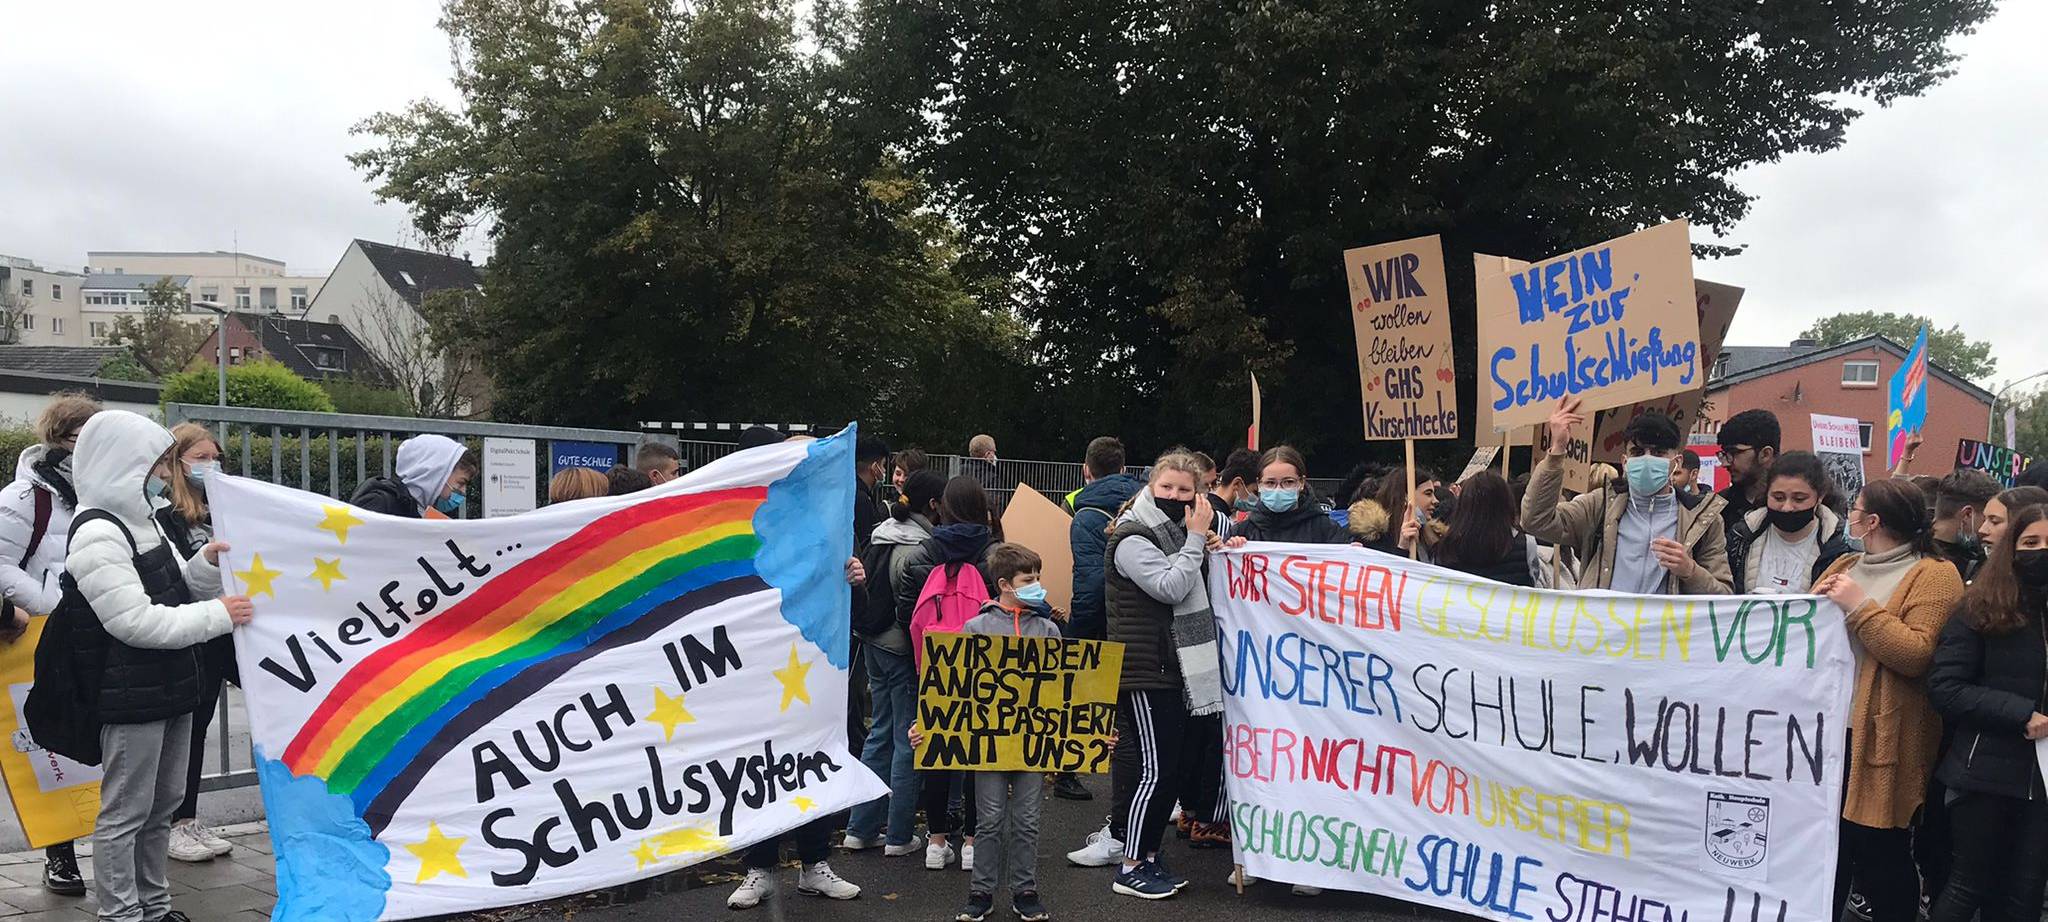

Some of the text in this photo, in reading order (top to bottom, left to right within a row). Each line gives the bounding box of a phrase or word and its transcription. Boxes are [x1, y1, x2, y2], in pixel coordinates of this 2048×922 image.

[1362, 253, 1427, 303] WIR
[1370, 303, 1432, 331] wollen
[1369, 336, 1434, 365] bleiben
[1385, 365, 1424, 400] GHS
[1365, 390, 1456, 439] Kirschhecke
[558, 455, 613, 468] GUTE SCHULE
[1224, 552, 1817, 669] WIR STEHEN GESCHLOSSEN VOR
[925, 634, 1102, 673] WIR HABEN
[471, 624, 743, 804] AUCH IM
[920, 699, 990, 732] WAS
[1218, 626, 1402, 724] UNSERER
[1624, 687, 1824, 786] WOLLEN
[921, 729, 1109, 773] MIT UNS?
[480, 739, 843, 887] Schulsystem
[1223, 723, 1632, 860] ABER NICHT VOR UNSERER
[1404, 834, 1544, 921] SCHULE
[1712, 850, 1757, 867] NEUWERK
